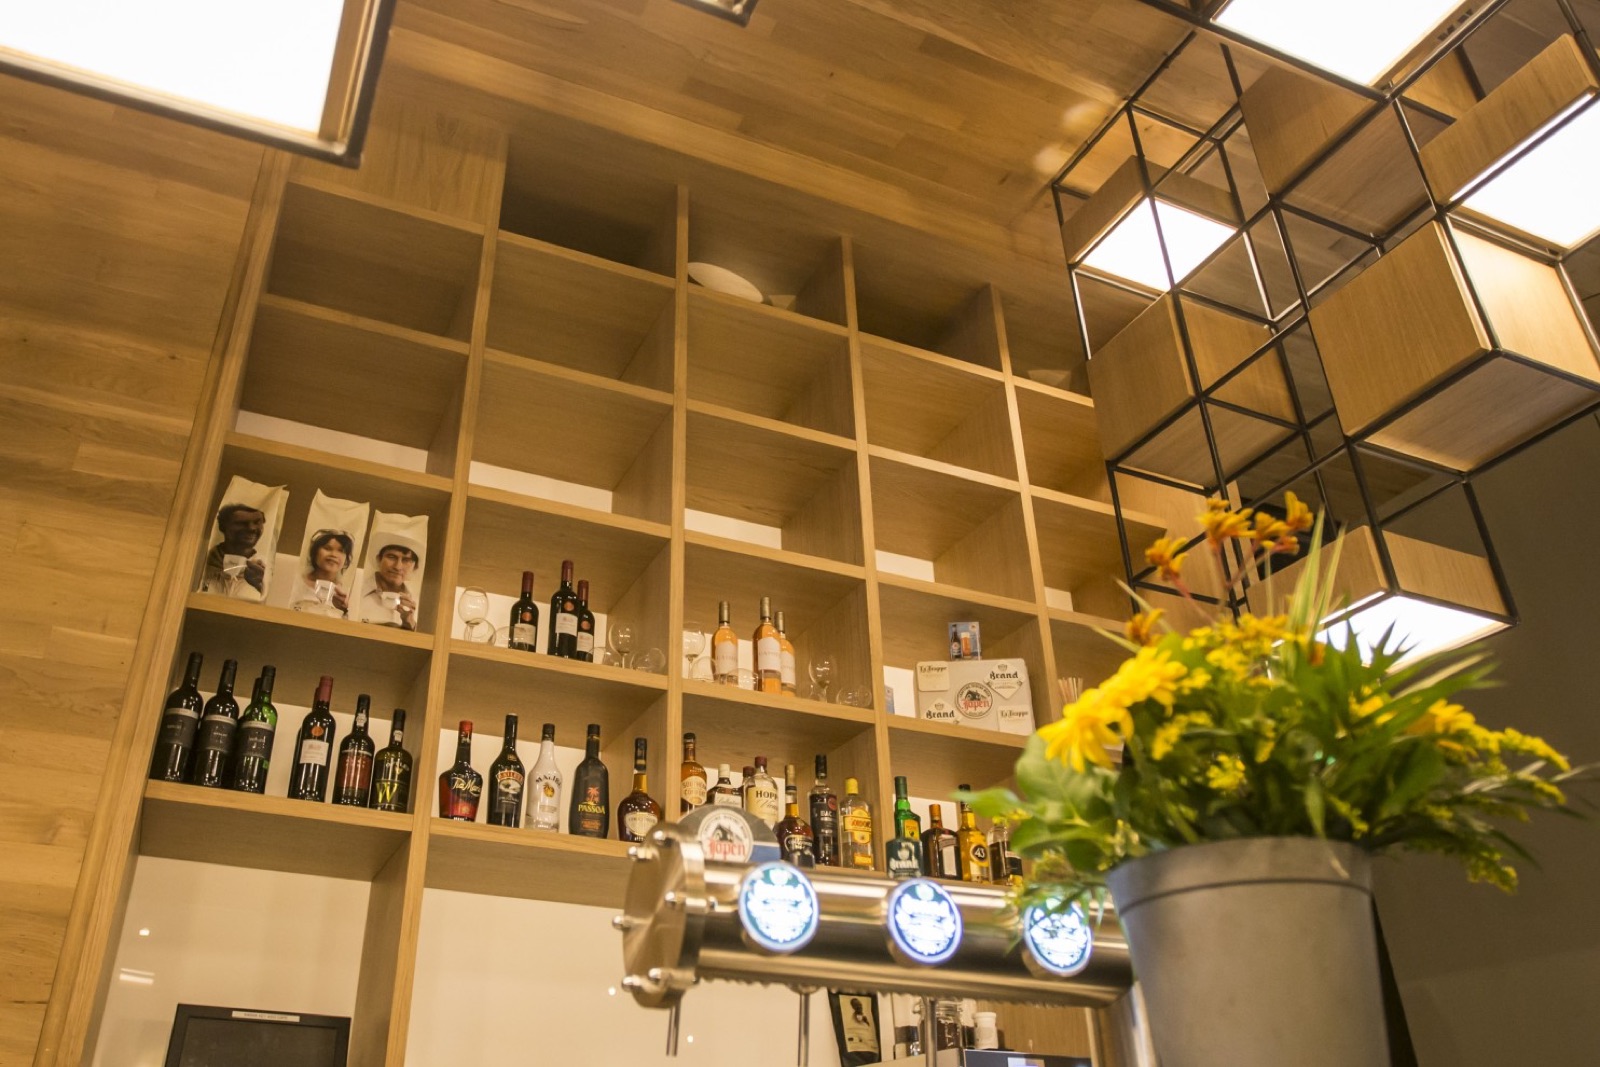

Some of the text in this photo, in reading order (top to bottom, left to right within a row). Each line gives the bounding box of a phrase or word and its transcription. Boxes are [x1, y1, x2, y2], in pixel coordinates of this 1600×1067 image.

[990, 670, 1019, 680] Brand
[926, 709, 955, 720] Brand
[974, 849, 985, 859] 43
